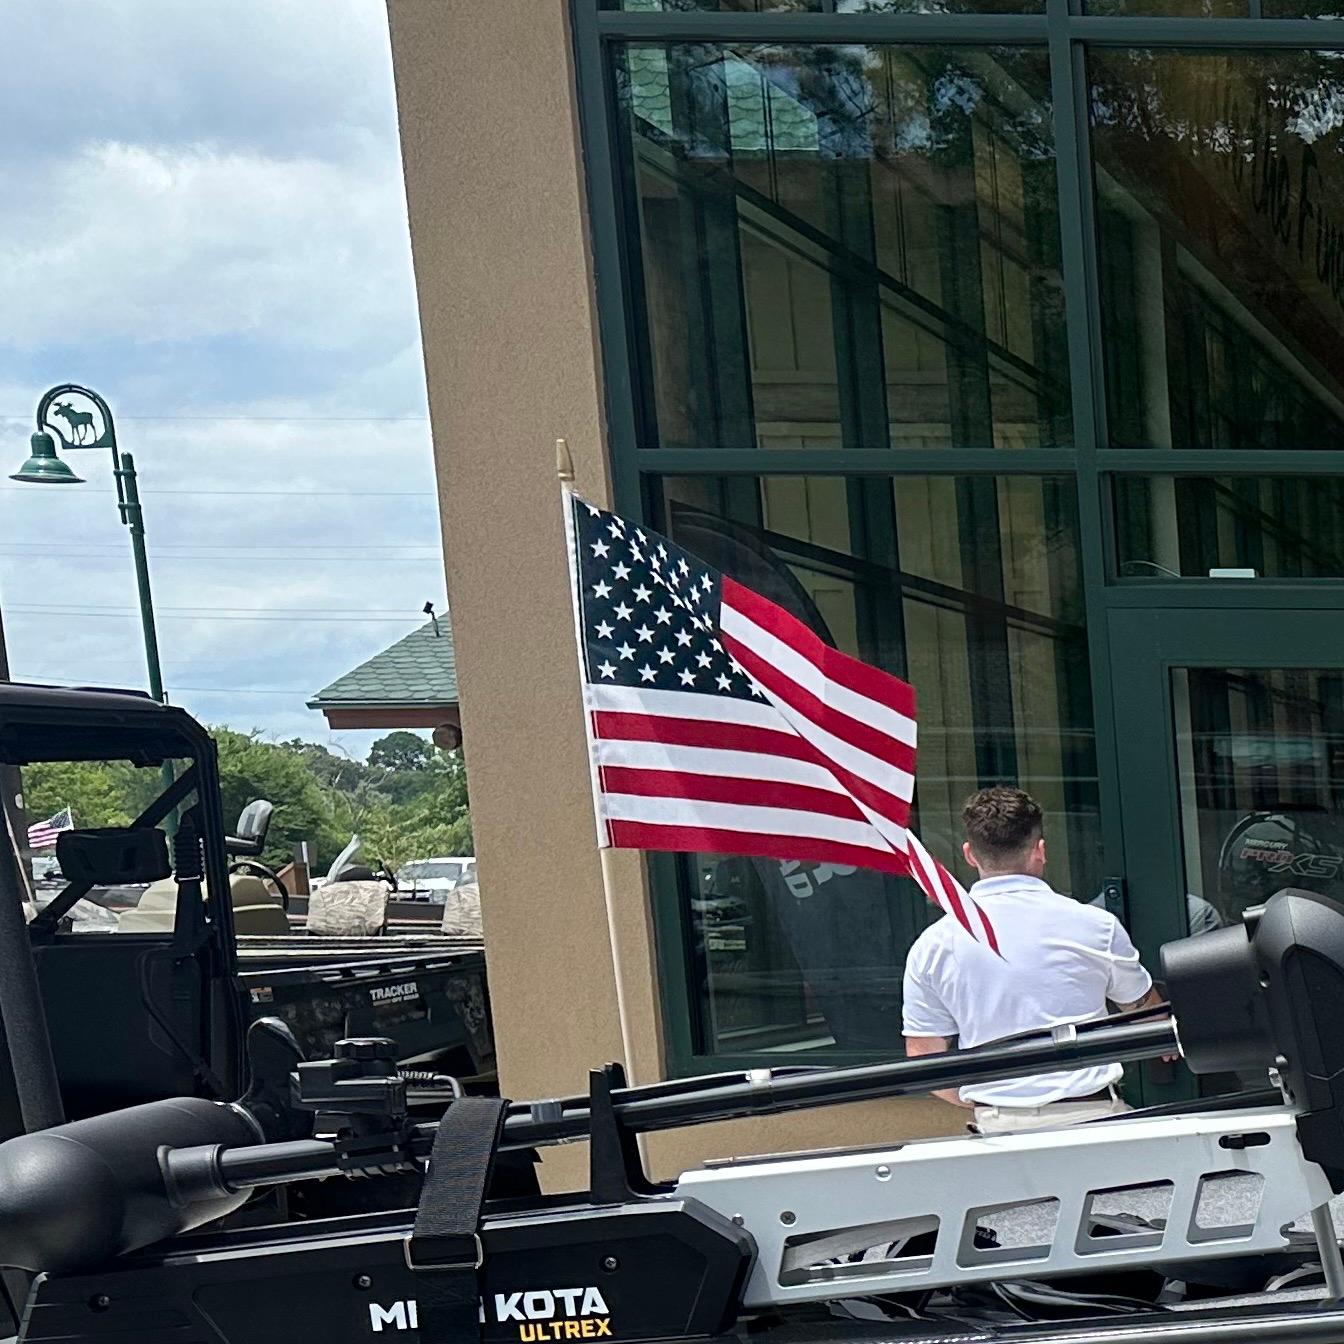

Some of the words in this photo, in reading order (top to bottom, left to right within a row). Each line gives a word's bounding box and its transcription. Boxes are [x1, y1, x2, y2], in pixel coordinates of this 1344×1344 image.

[369, 982, 418, 1001] TRACKER
[495, 1286, 610, 1322] KOTA
[519, 1318, 613, 1342] ULTREX
